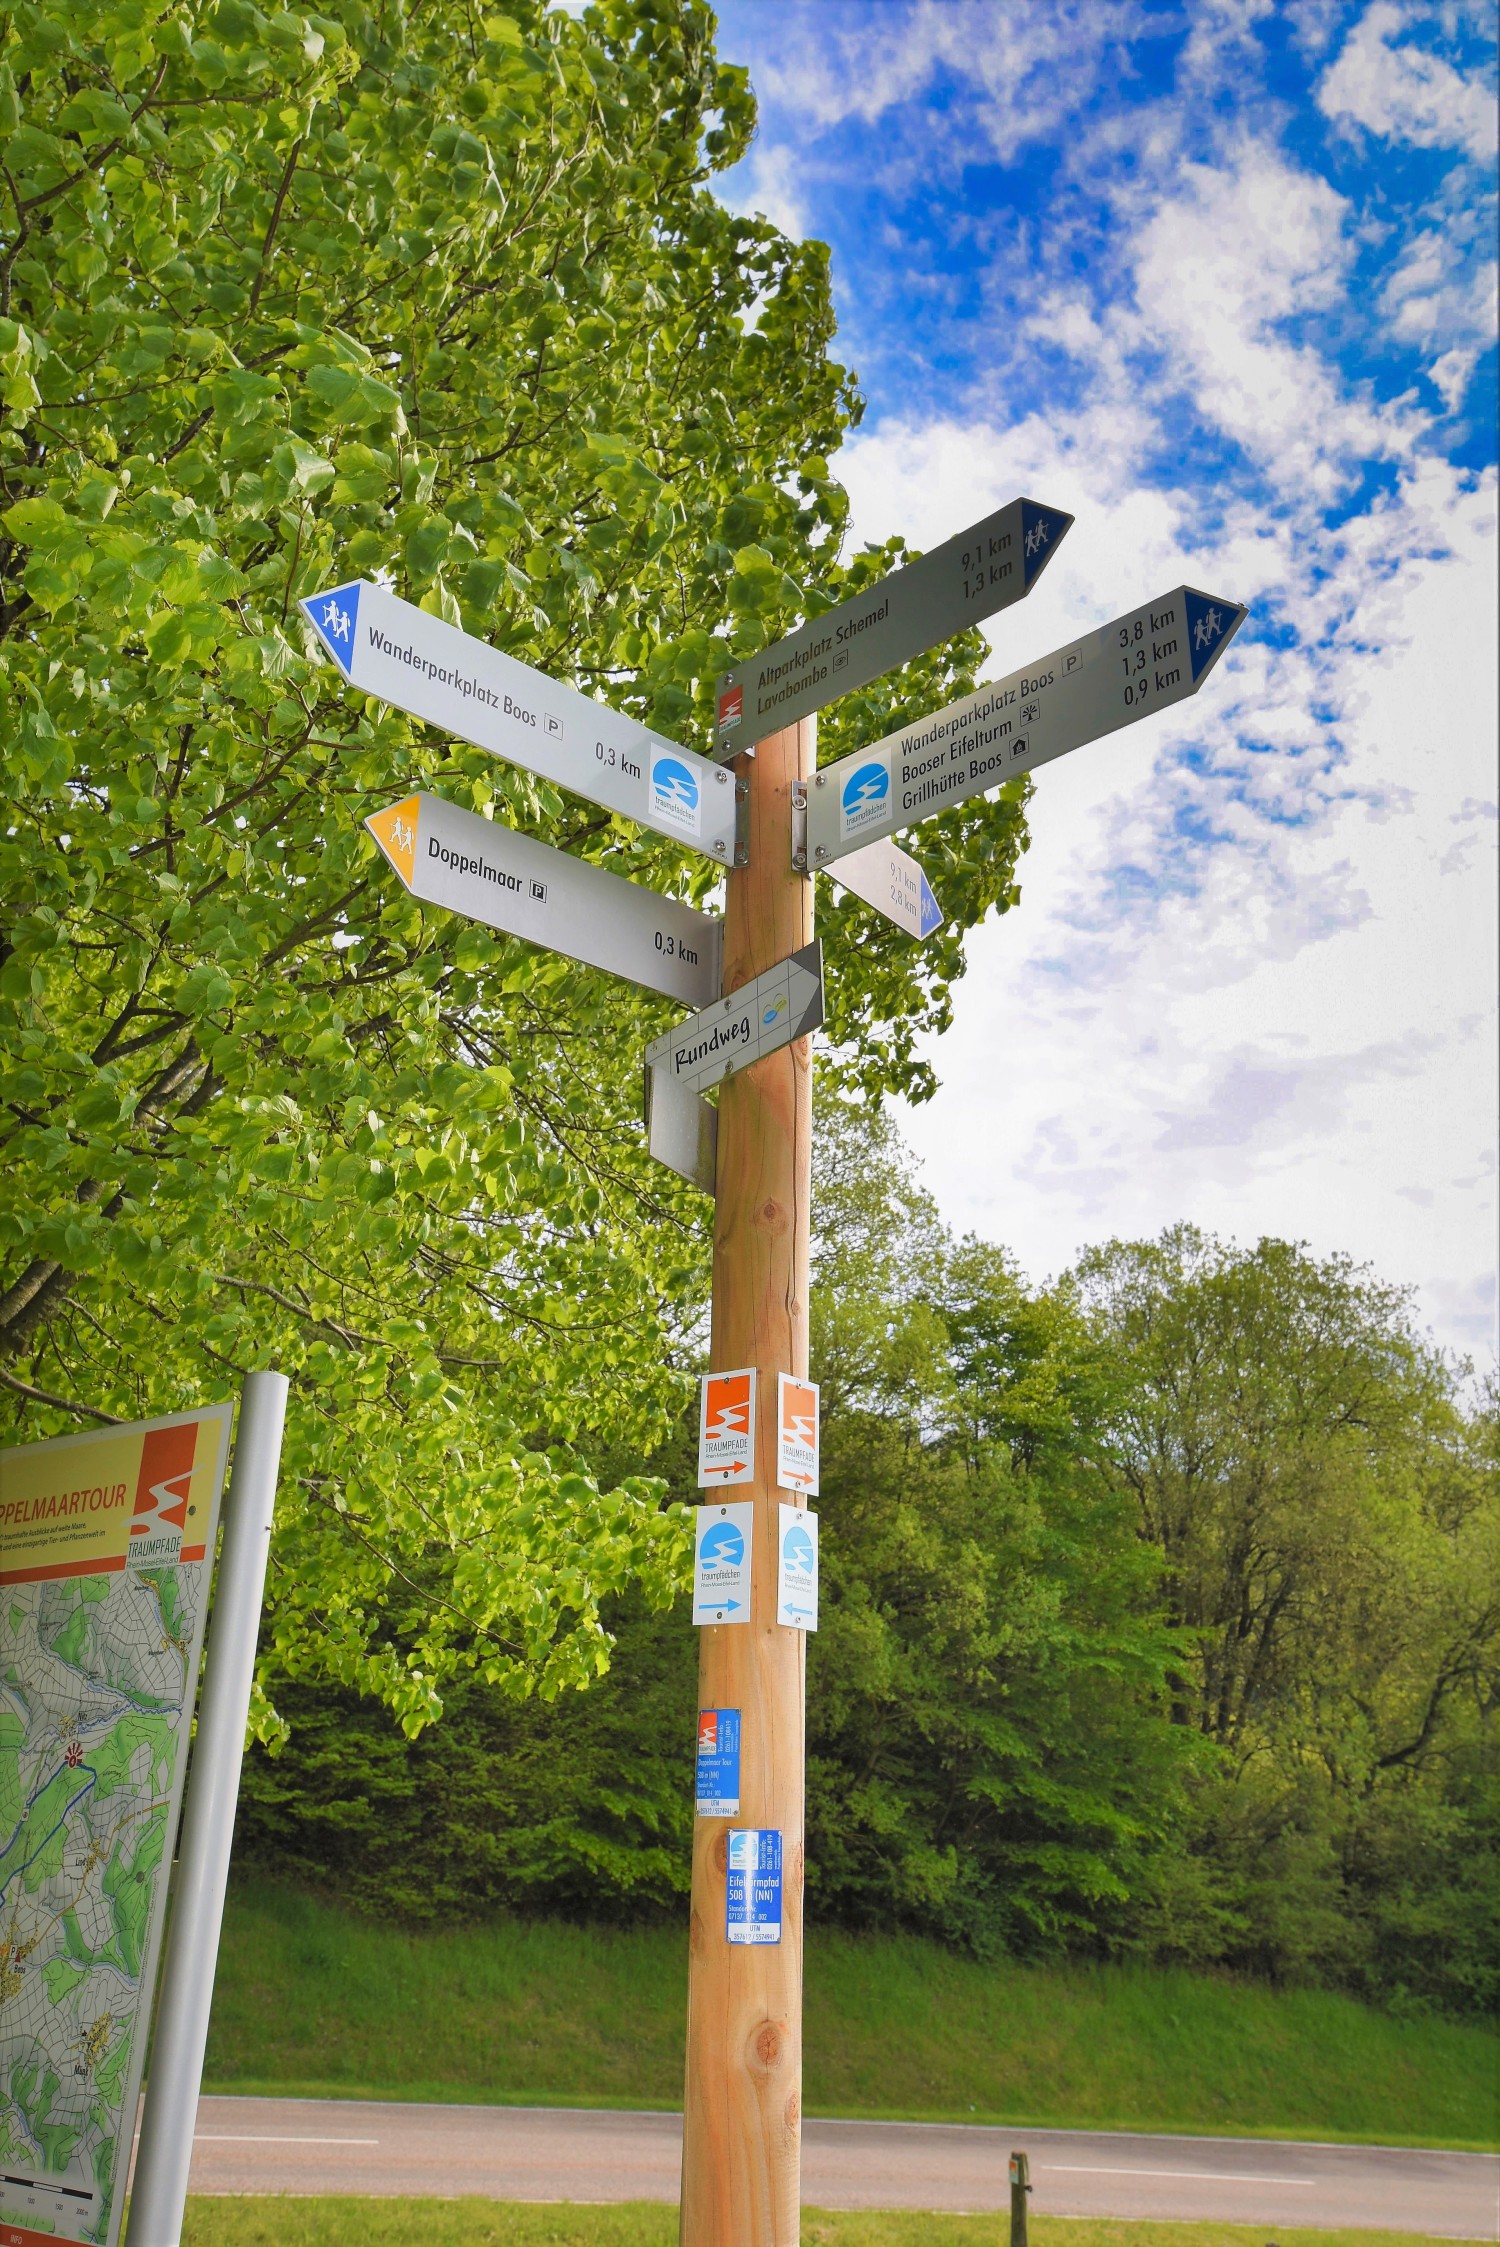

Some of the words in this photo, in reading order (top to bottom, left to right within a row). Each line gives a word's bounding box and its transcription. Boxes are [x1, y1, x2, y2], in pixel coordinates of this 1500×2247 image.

[962, 545, 982, 573] 9,1
[988, 532, 1012, 558] km
[963, 574, 985, 599] 1,3
[990, 561, 1013, 585] km
[758, 636, 833, 690] Altparkplatz
[836, 599, 889, 645] Schemel
[1119, 622, 1144, 649] 3,8
[1149, 609, 1175, 635] km
[368, 626, 499, 709] Wanderparkplatz
[503, 695, 537, 728] Boos
[1122, 653, 1146, 678] 1,3
[1152, 638, 1178, 662] km
[758, 664, 828, 715] Lavabombe
[1124, 683, 1150, 707] 0,9
[1155, 668, 1181, 692] km
[901, 689, 1017, 757] Wanderparkplatz
[1020, 668, 1055, 699] Boos
[595, 741, 616, 768] 0,3
[620, 756, 642, 780] km
[902, 755, 946, 784] Booser
[949, 719, 1013, 762] Eifelturm
[902, 770, 966, 811] Grillhütte
[969, 752, 1003, 781] Boos
[428, 836, 523, 894] Doppelmaar
[890, 862, 902, 883] 9,1
[904, 871, 917, 895] km
[890, 885, 903, 905] 2,8
[904, 893, 917, 917] km
[654, 931, 675, 956] 0,3
[678, 939, 698, 966] km
[675, 1016, 751, 1074] Rundweg
[705, 1438, 748, 1453] TRAUMPFADE
[783, 1444, 815, 1463] TRAUMPFADE
[128, 1536, 182, 1559] TRAUMPFADE
[722, 1758, 732, 1766] Tour
[729, 1875, 780, 1890] Eifelrmpfad
[729, 1889, 743, 1901] 508
[755, 1889, 773, 1903] (NN)
[749, 1924, 761, 1932] UTM
